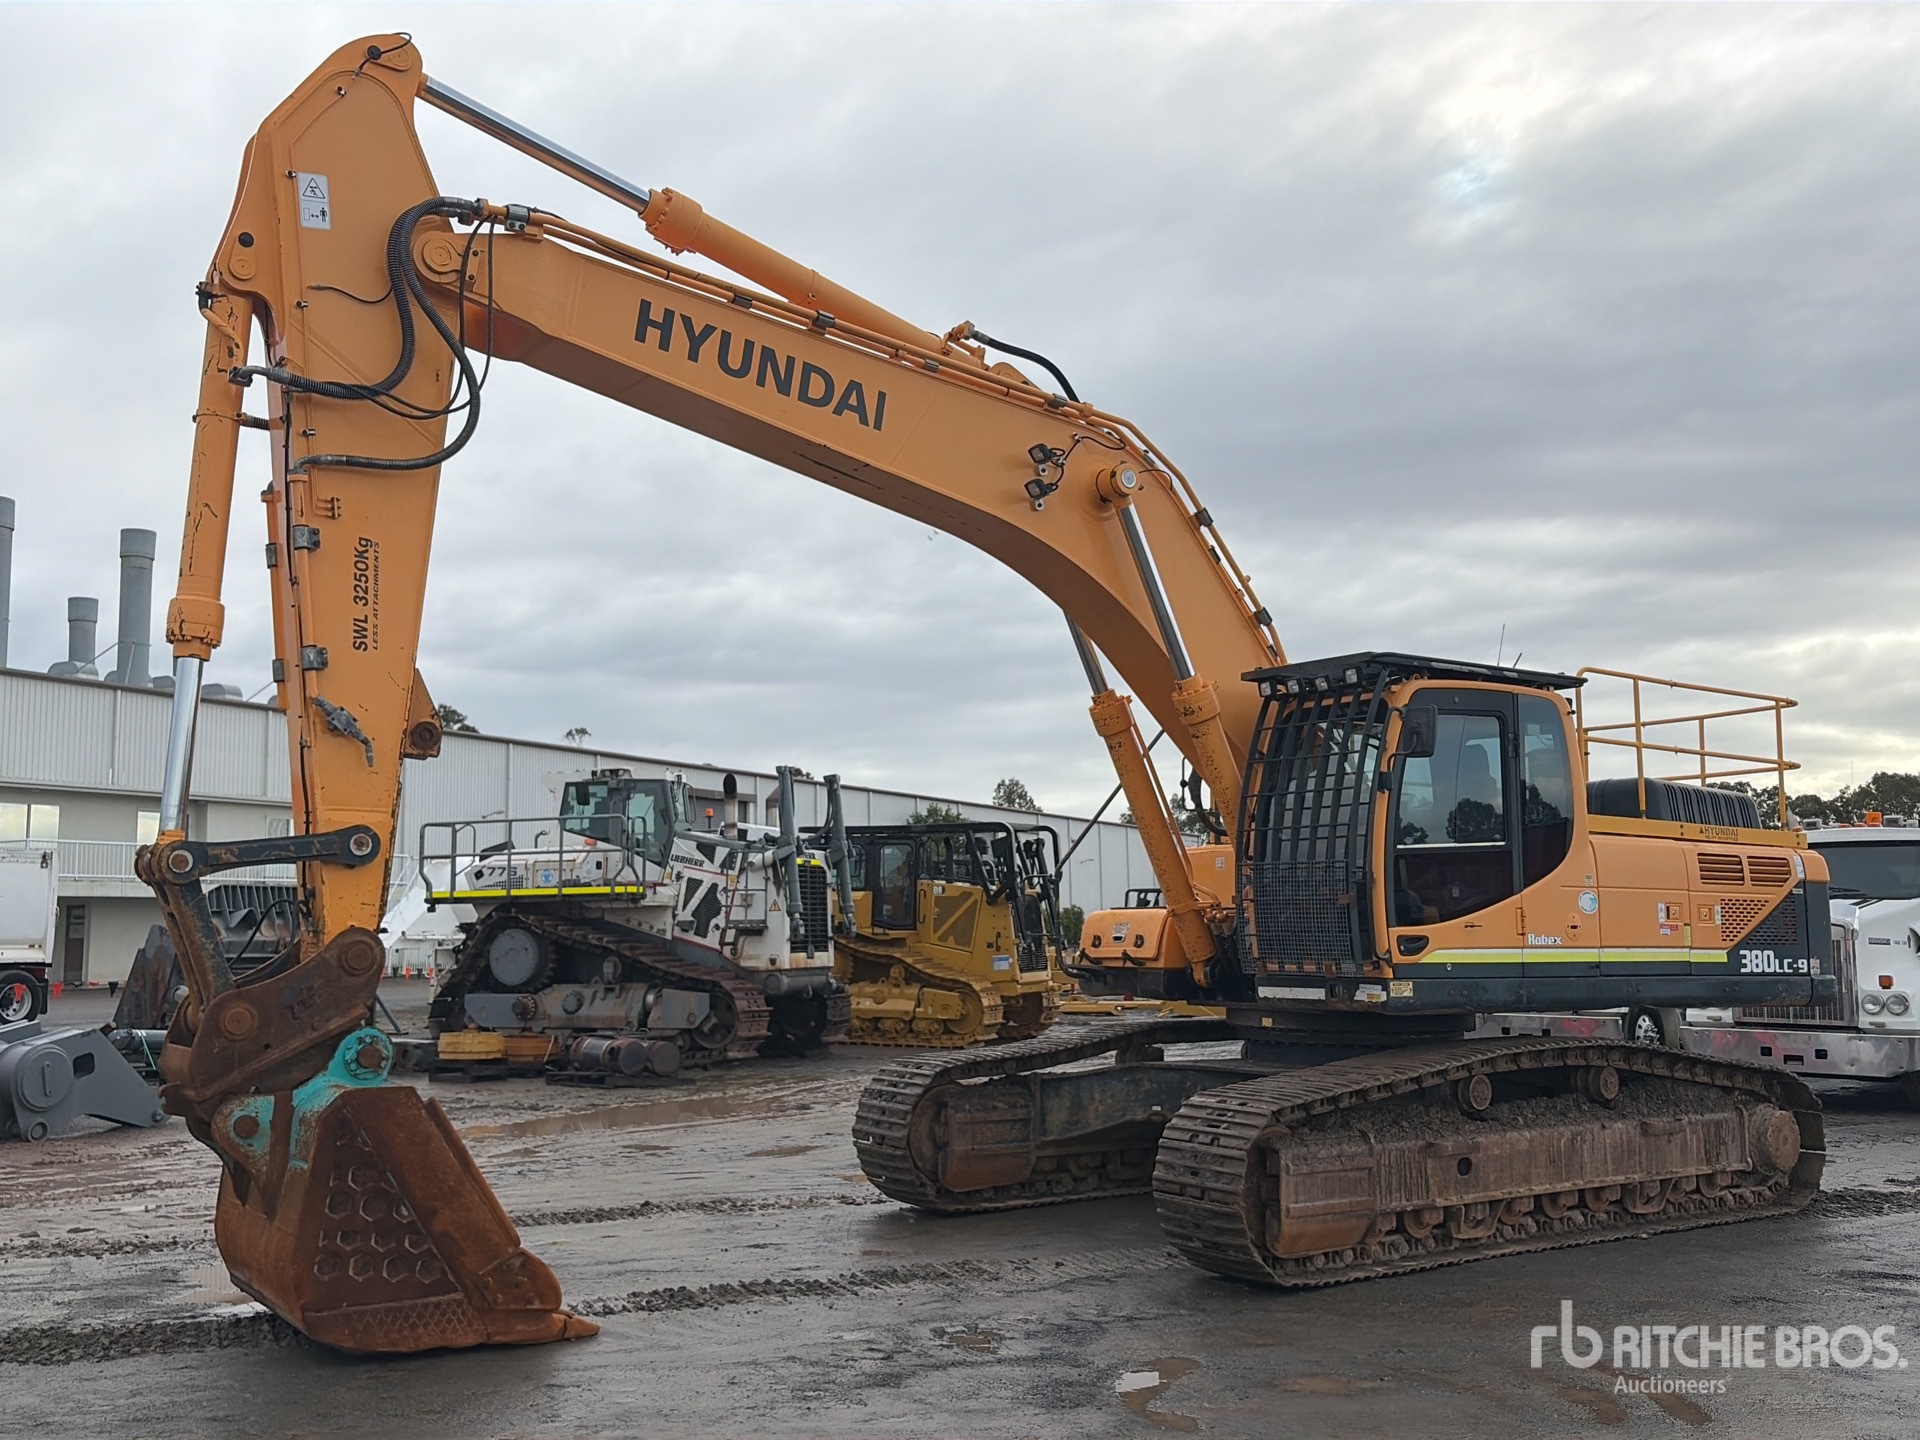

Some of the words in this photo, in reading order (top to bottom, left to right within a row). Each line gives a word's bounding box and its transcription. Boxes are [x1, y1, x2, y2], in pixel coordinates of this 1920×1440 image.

[634, 298, 887, 432] HYUNDAI
[353, 536, 374, 607] 3250Kg
[372, 541, 381, 621] ATTACHMENTS
[352, 614, 369, 652] SWL
[372, 623, 380, 651] LESS
[1704, 826, 1739, 838] HYUNDAI
[670, 853, 706, 868] LIEBHERR
[1527, 933, 1562, 945] Robex
[1739, 949, 1808, 973] 380LC-9
